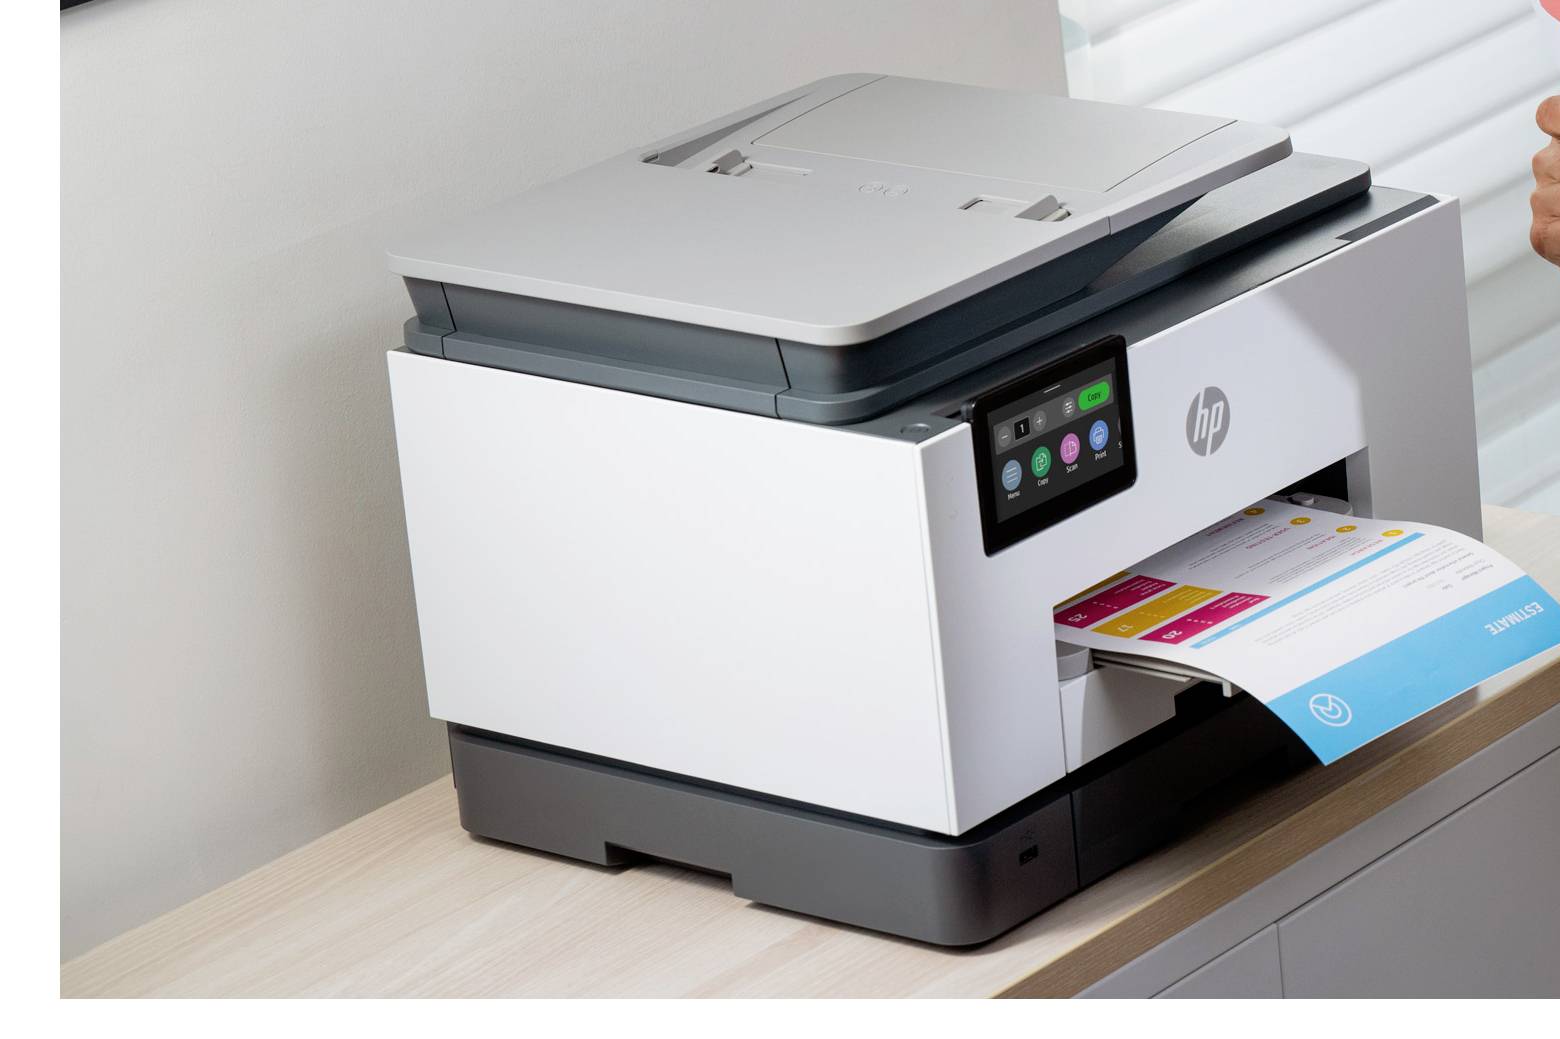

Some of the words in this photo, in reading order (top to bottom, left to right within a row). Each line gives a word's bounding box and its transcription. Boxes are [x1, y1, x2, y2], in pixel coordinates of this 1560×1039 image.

[1087, 391, 1102, 402] Copy
[1192, 387, 1226, 456] hp
[1094, 450, 1107, 461] Print
[1066, 463, 1079, 474] Scan
[1037, 477, 1049, 487] Copy
[1007, 490, 1021, 501] Menu
[1068, 613, 1089, 624] 25
[1483, 601, 1545, 636] ESTIMATE
[1161, 629, 1183, 640] 20
